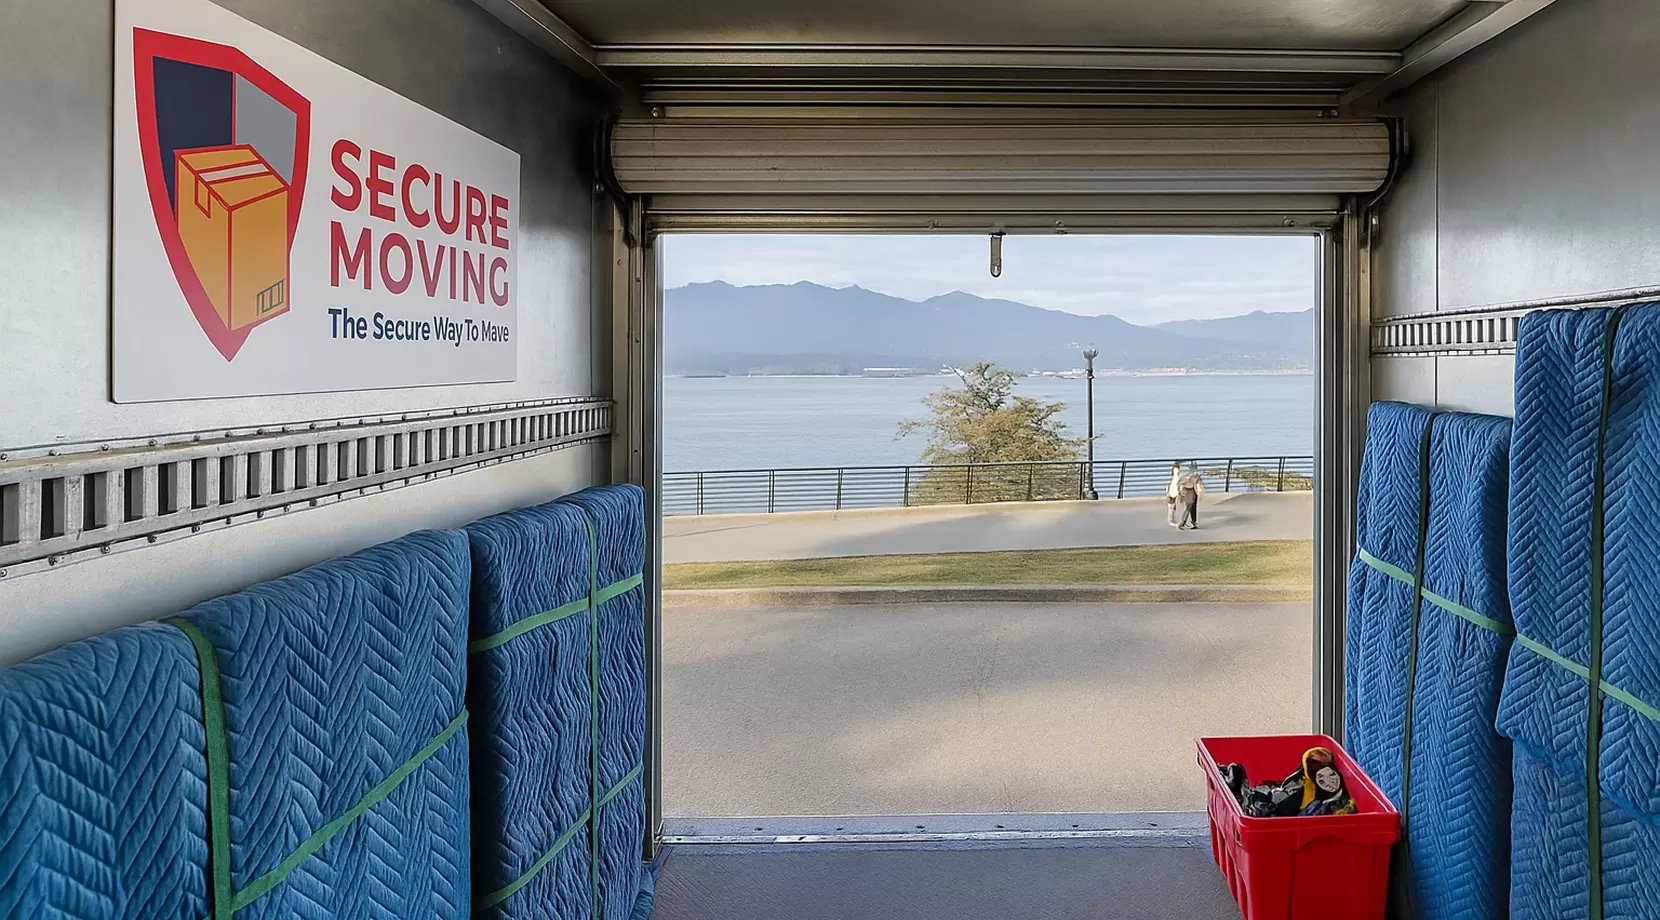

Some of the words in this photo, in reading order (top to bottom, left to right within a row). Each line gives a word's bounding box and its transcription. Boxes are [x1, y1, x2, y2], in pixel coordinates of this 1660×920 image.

[331, 139, 509, 250] SECURE
[330, 220, 509, 307] MOVING
[328, 308, 367, 339] The
[372, 312, 430, 340] Secure
[433, 316, 463, 347] Way
[465, 319, 479, 341] To
[481, 320, 509, 342] Mave
